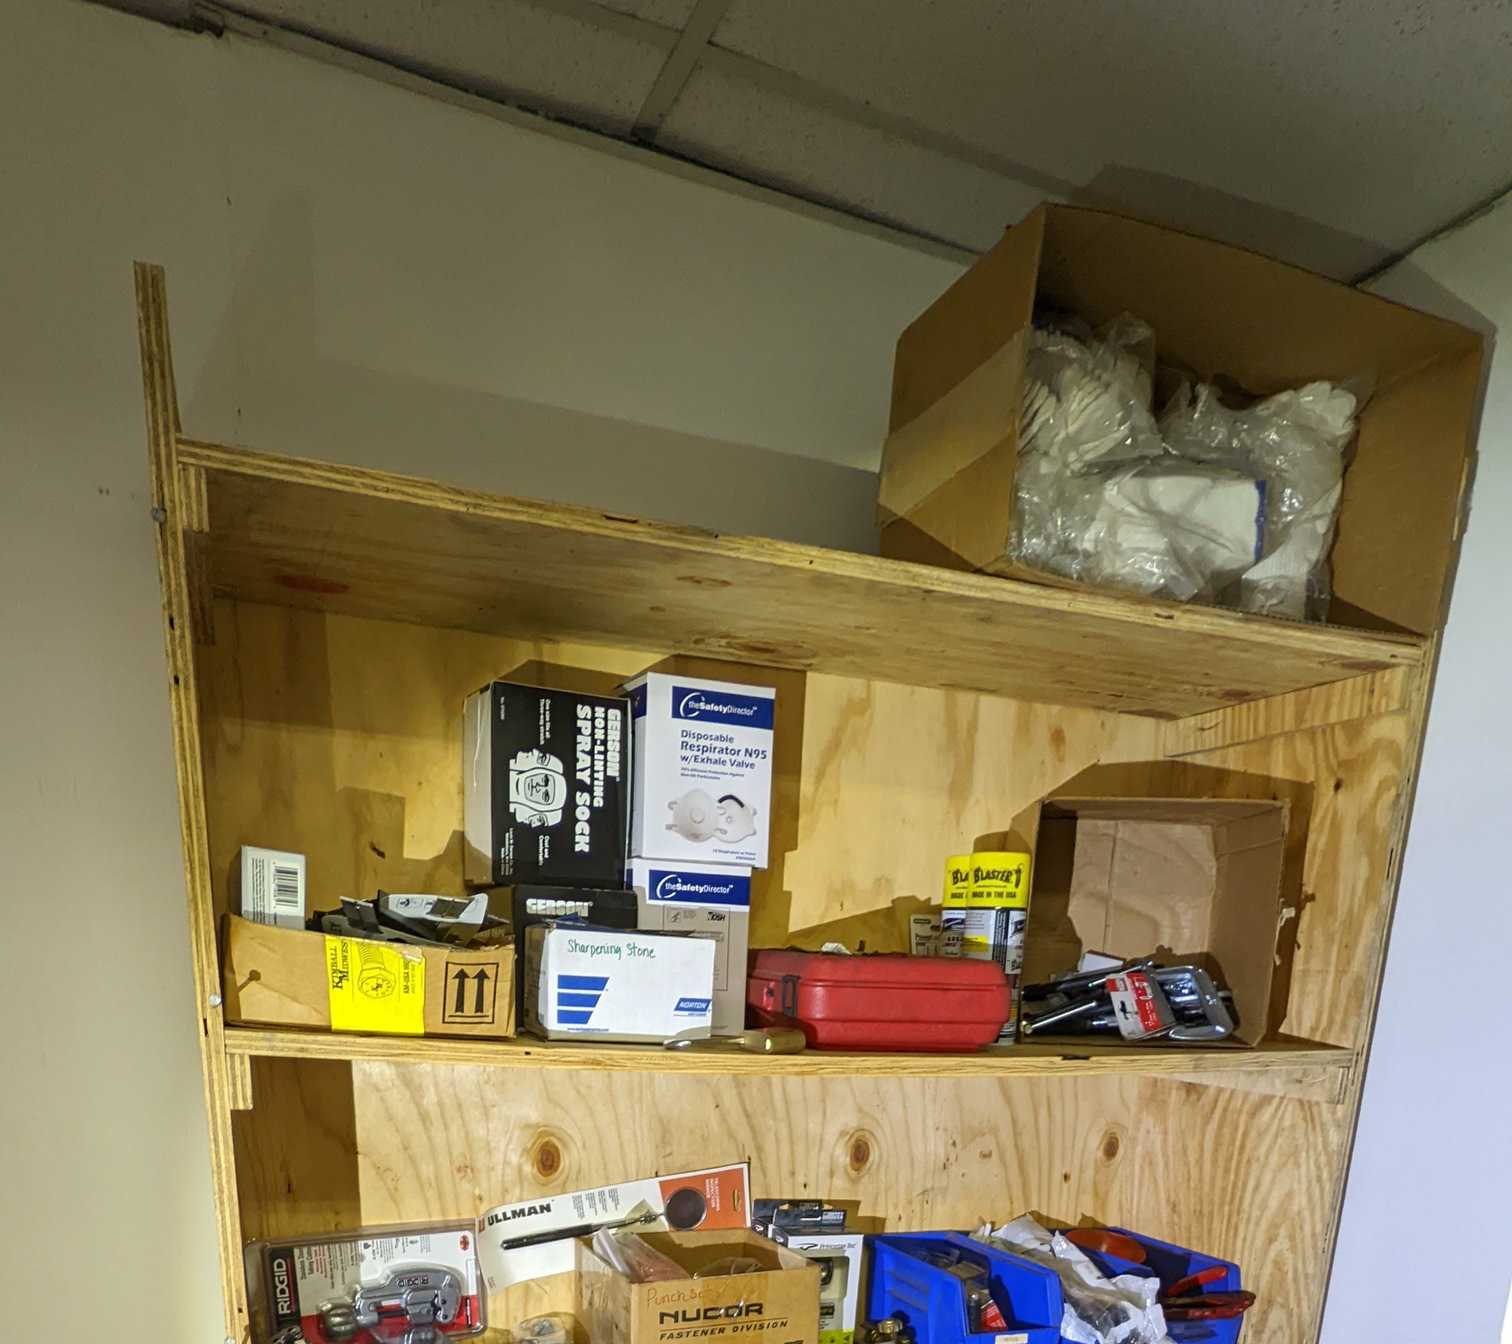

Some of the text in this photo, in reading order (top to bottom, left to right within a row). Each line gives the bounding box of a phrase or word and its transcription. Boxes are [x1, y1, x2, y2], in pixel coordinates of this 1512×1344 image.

[606, 708, 621, 777] GERSON
[680, 729, 734, 744] Disposable
[593, 706, 605, 807] NON-LINTING
[680, 741, 767, 760] Respirator N95
[680, 754, 755, 769] w/Exhale Valve
[574, 704, 592, 853] SPRAY SOCK
[567, 940, 656, 960] Sharpening Stone
[487, 1203, 552, 1226] ULLMAN
[273, 1258, 290, 1315] RIDGID
[659, 1303, 763, 1325] NUCOR
[659, 1320, 789, 1341] FASTENER DIVISION
